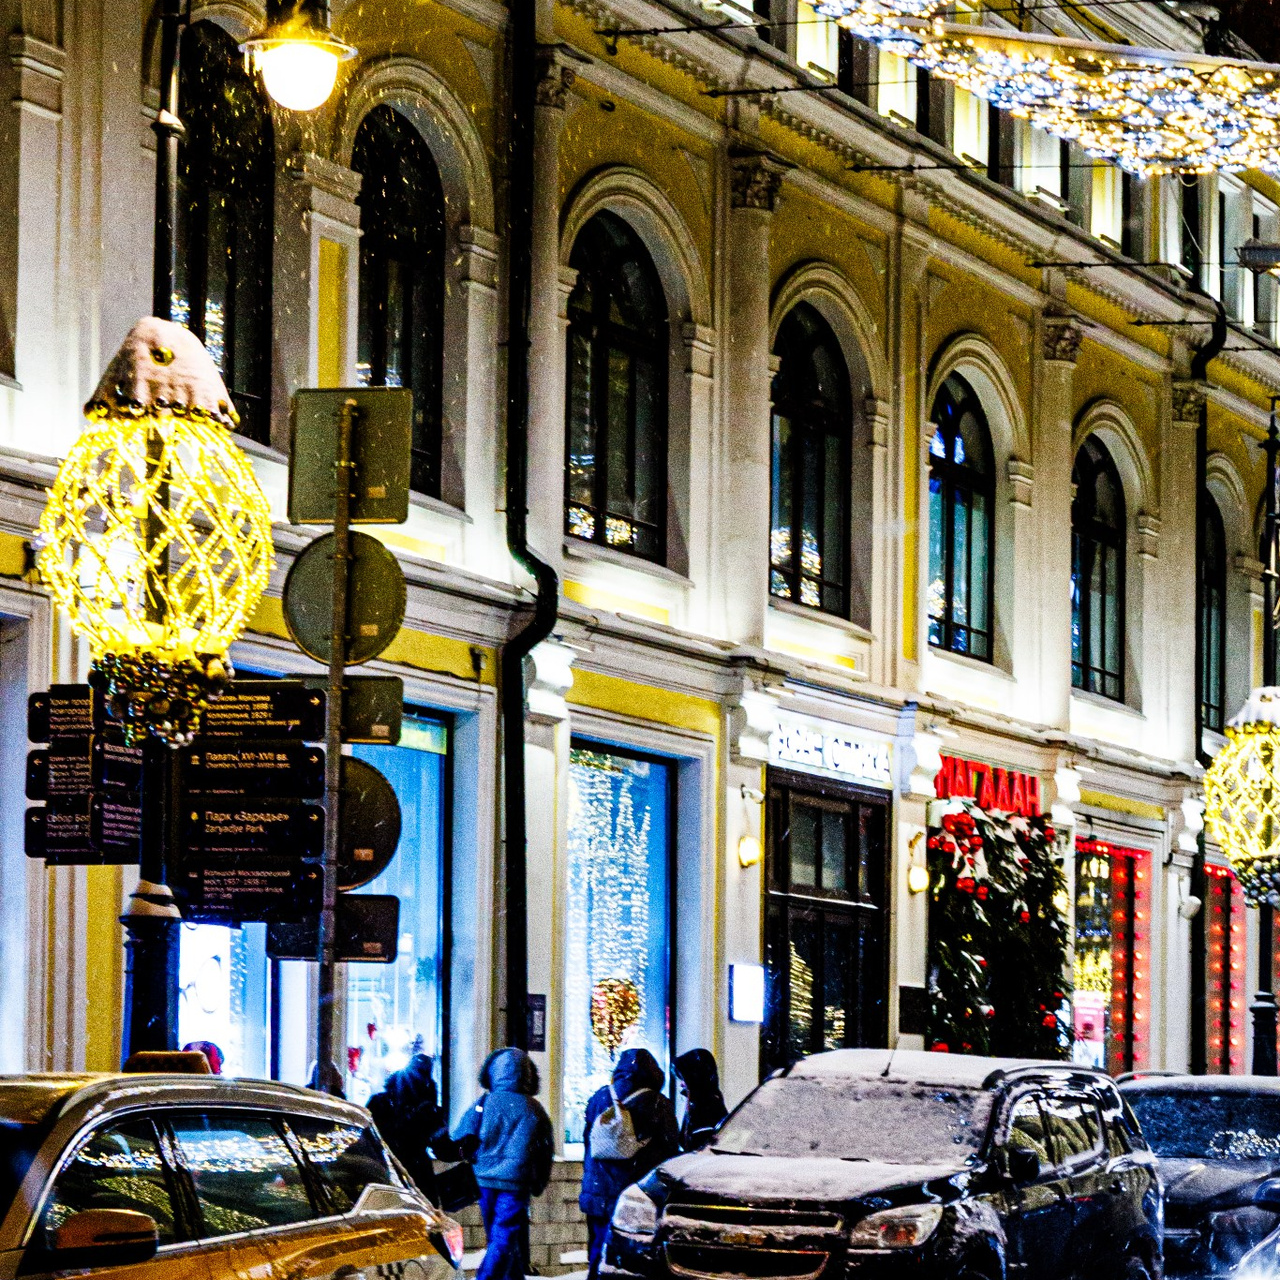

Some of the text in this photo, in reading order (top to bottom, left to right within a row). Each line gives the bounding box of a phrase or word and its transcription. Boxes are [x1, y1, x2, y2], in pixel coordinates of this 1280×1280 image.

[933, 752, 1041, 818] МАГАДАН
[204, 811, 232, 823] Парк
[245, 824, 265, 833] Park
